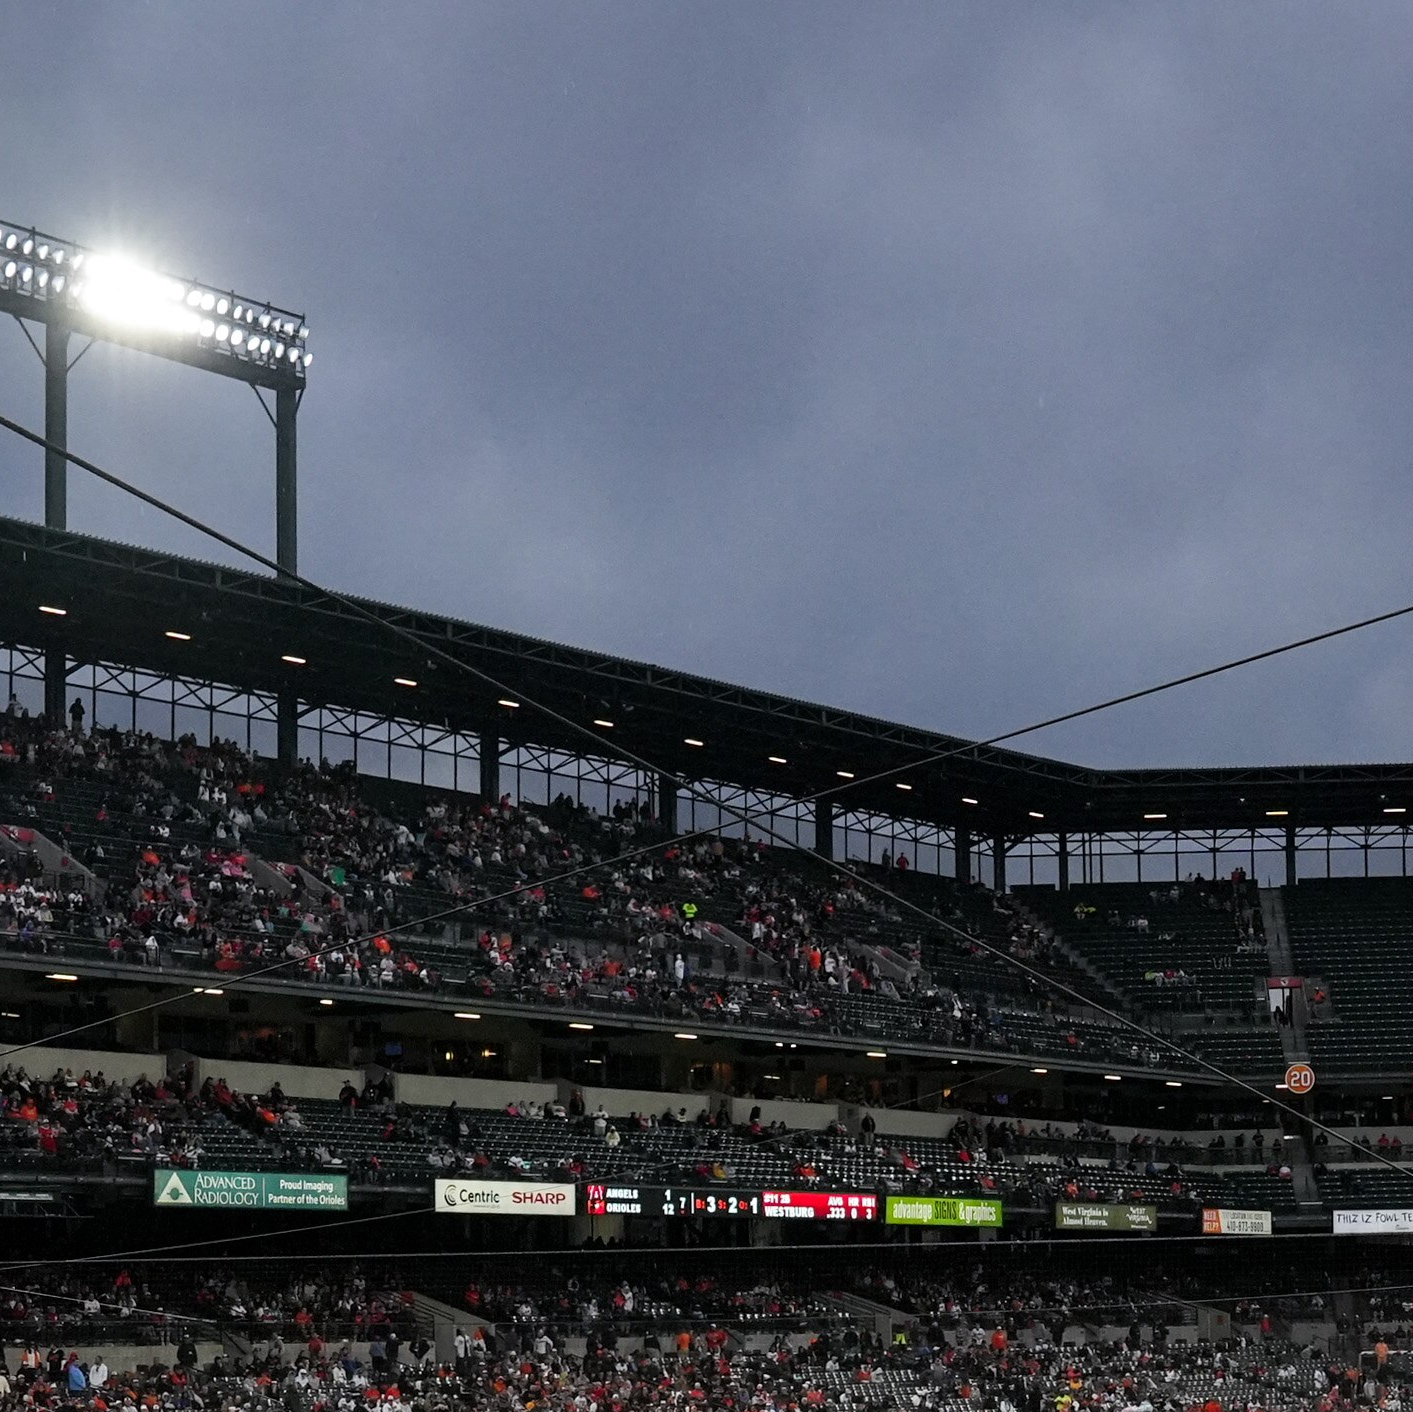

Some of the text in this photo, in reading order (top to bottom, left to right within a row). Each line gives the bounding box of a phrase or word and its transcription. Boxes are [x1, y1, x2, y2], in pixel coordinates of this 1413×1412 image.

[1290, 1070, 1310, 1087] 20
[194, 1173, 256, 1190] ADVANCED
[280, 1179, 334, 1194] Proud Imaging
[194, 1188, 259, 1206] RADIOLOGY
[268, 1193, 345, 1205] Partner of the Orioles
[459, 1189, 566, 1205] Centric SHARP
[606, 1188, 671, 1200] ANGELS 1
[828, 1196, 843, 1206] AVG
[848, 1197, 859, 1207] HR
[606, 1202, 675, 1215] ORIOLES 12
[679, 1197, 686, 1208] 7
[707, 1196, 717, 1213] 3
[728, 1197, 738, 1213] 2
[750, 1197, 758, 1214] 1
[764, 1205, 815, 1218] WESTBURG
[826, 1207, 846, 1219] .333
[866, 1208, 872, 1220] 3
[892, 1201, 933, 1221] advantage
[1078, 1206, 1102, 1217] Virginia
[1376, 1212, 1400, 1222] FOWL
